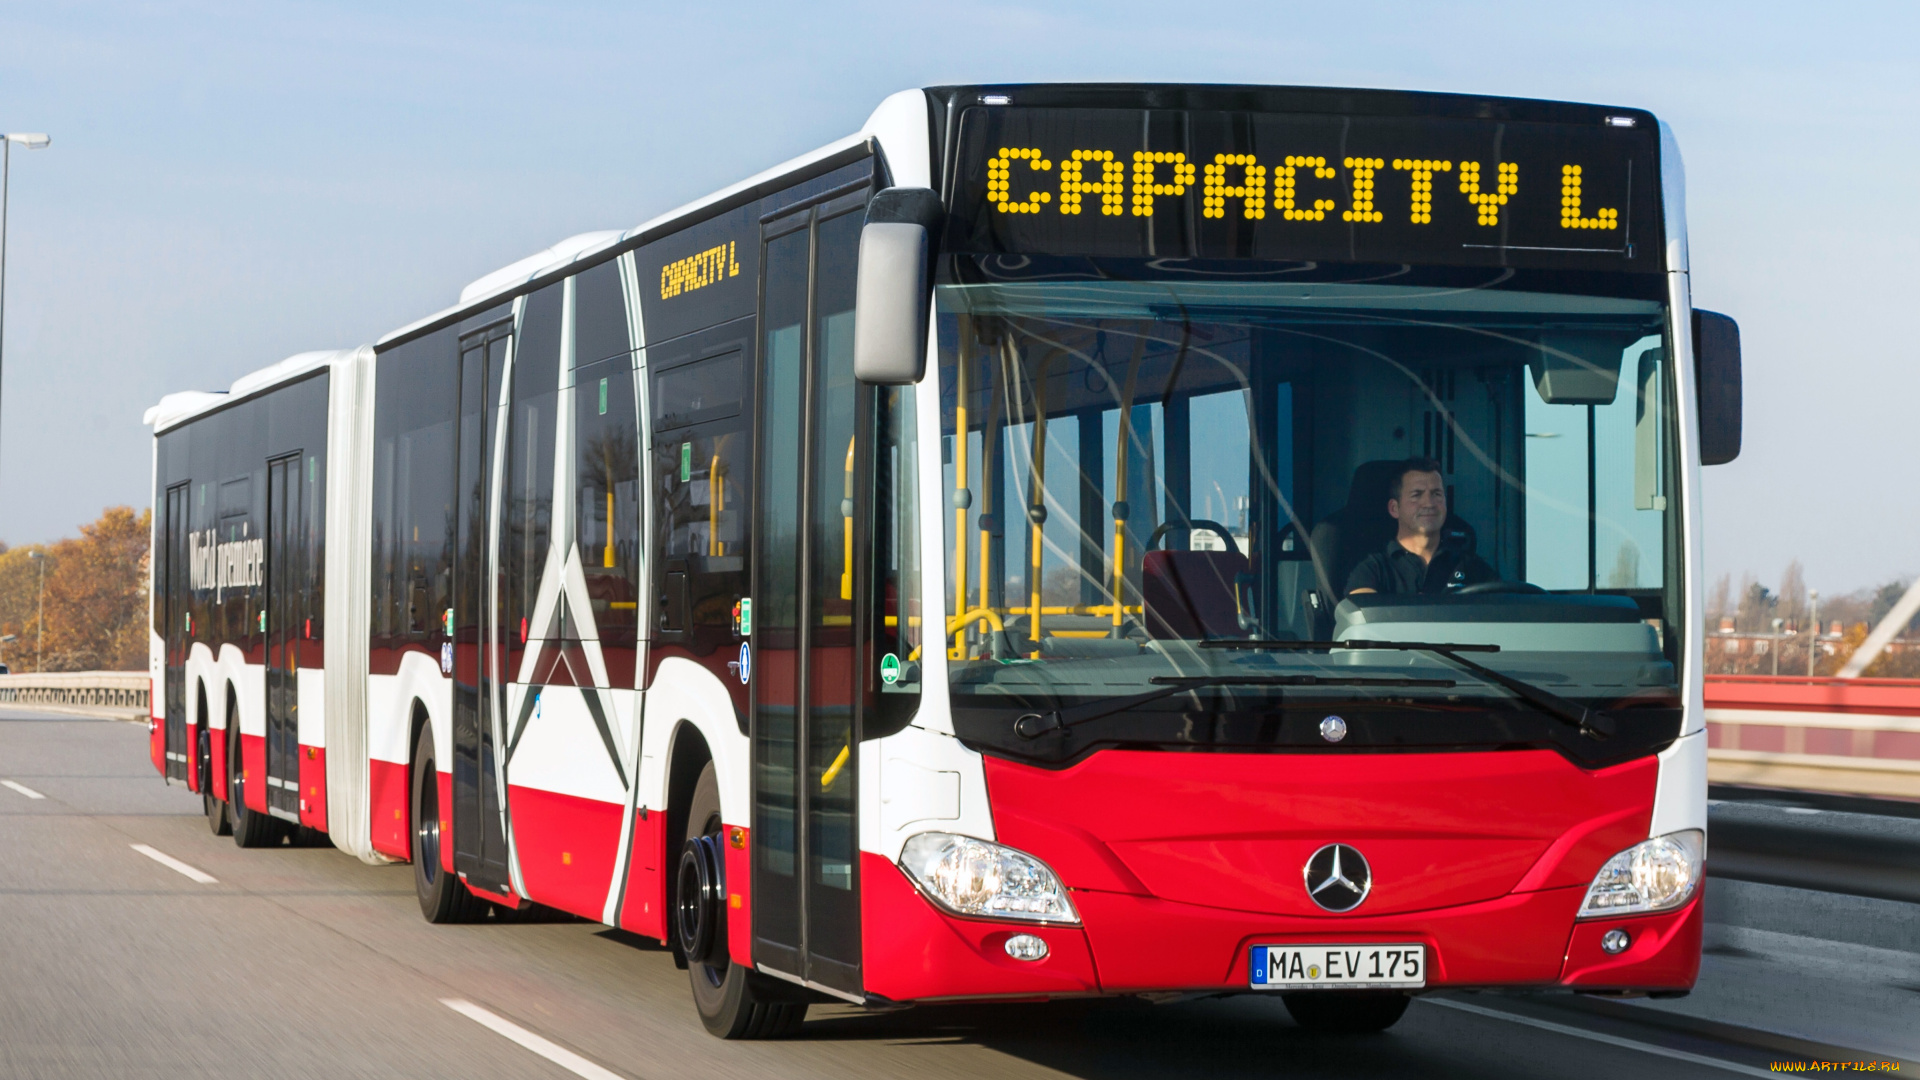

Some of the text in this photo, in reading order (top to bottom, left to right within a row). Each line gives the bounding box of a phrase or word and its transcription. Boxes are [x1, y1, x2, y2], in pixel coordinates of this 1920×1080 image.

[987, 148, 1618, 229] CAPACITY L
[660, 240, 740, 300] CAPACITY L
[189, 521, 264, 605] World premiere
[1269, 951, 1305, 979] MA
[1325, 951, 1361, 978] EV
[1368, 950, 1419, 978] 175
